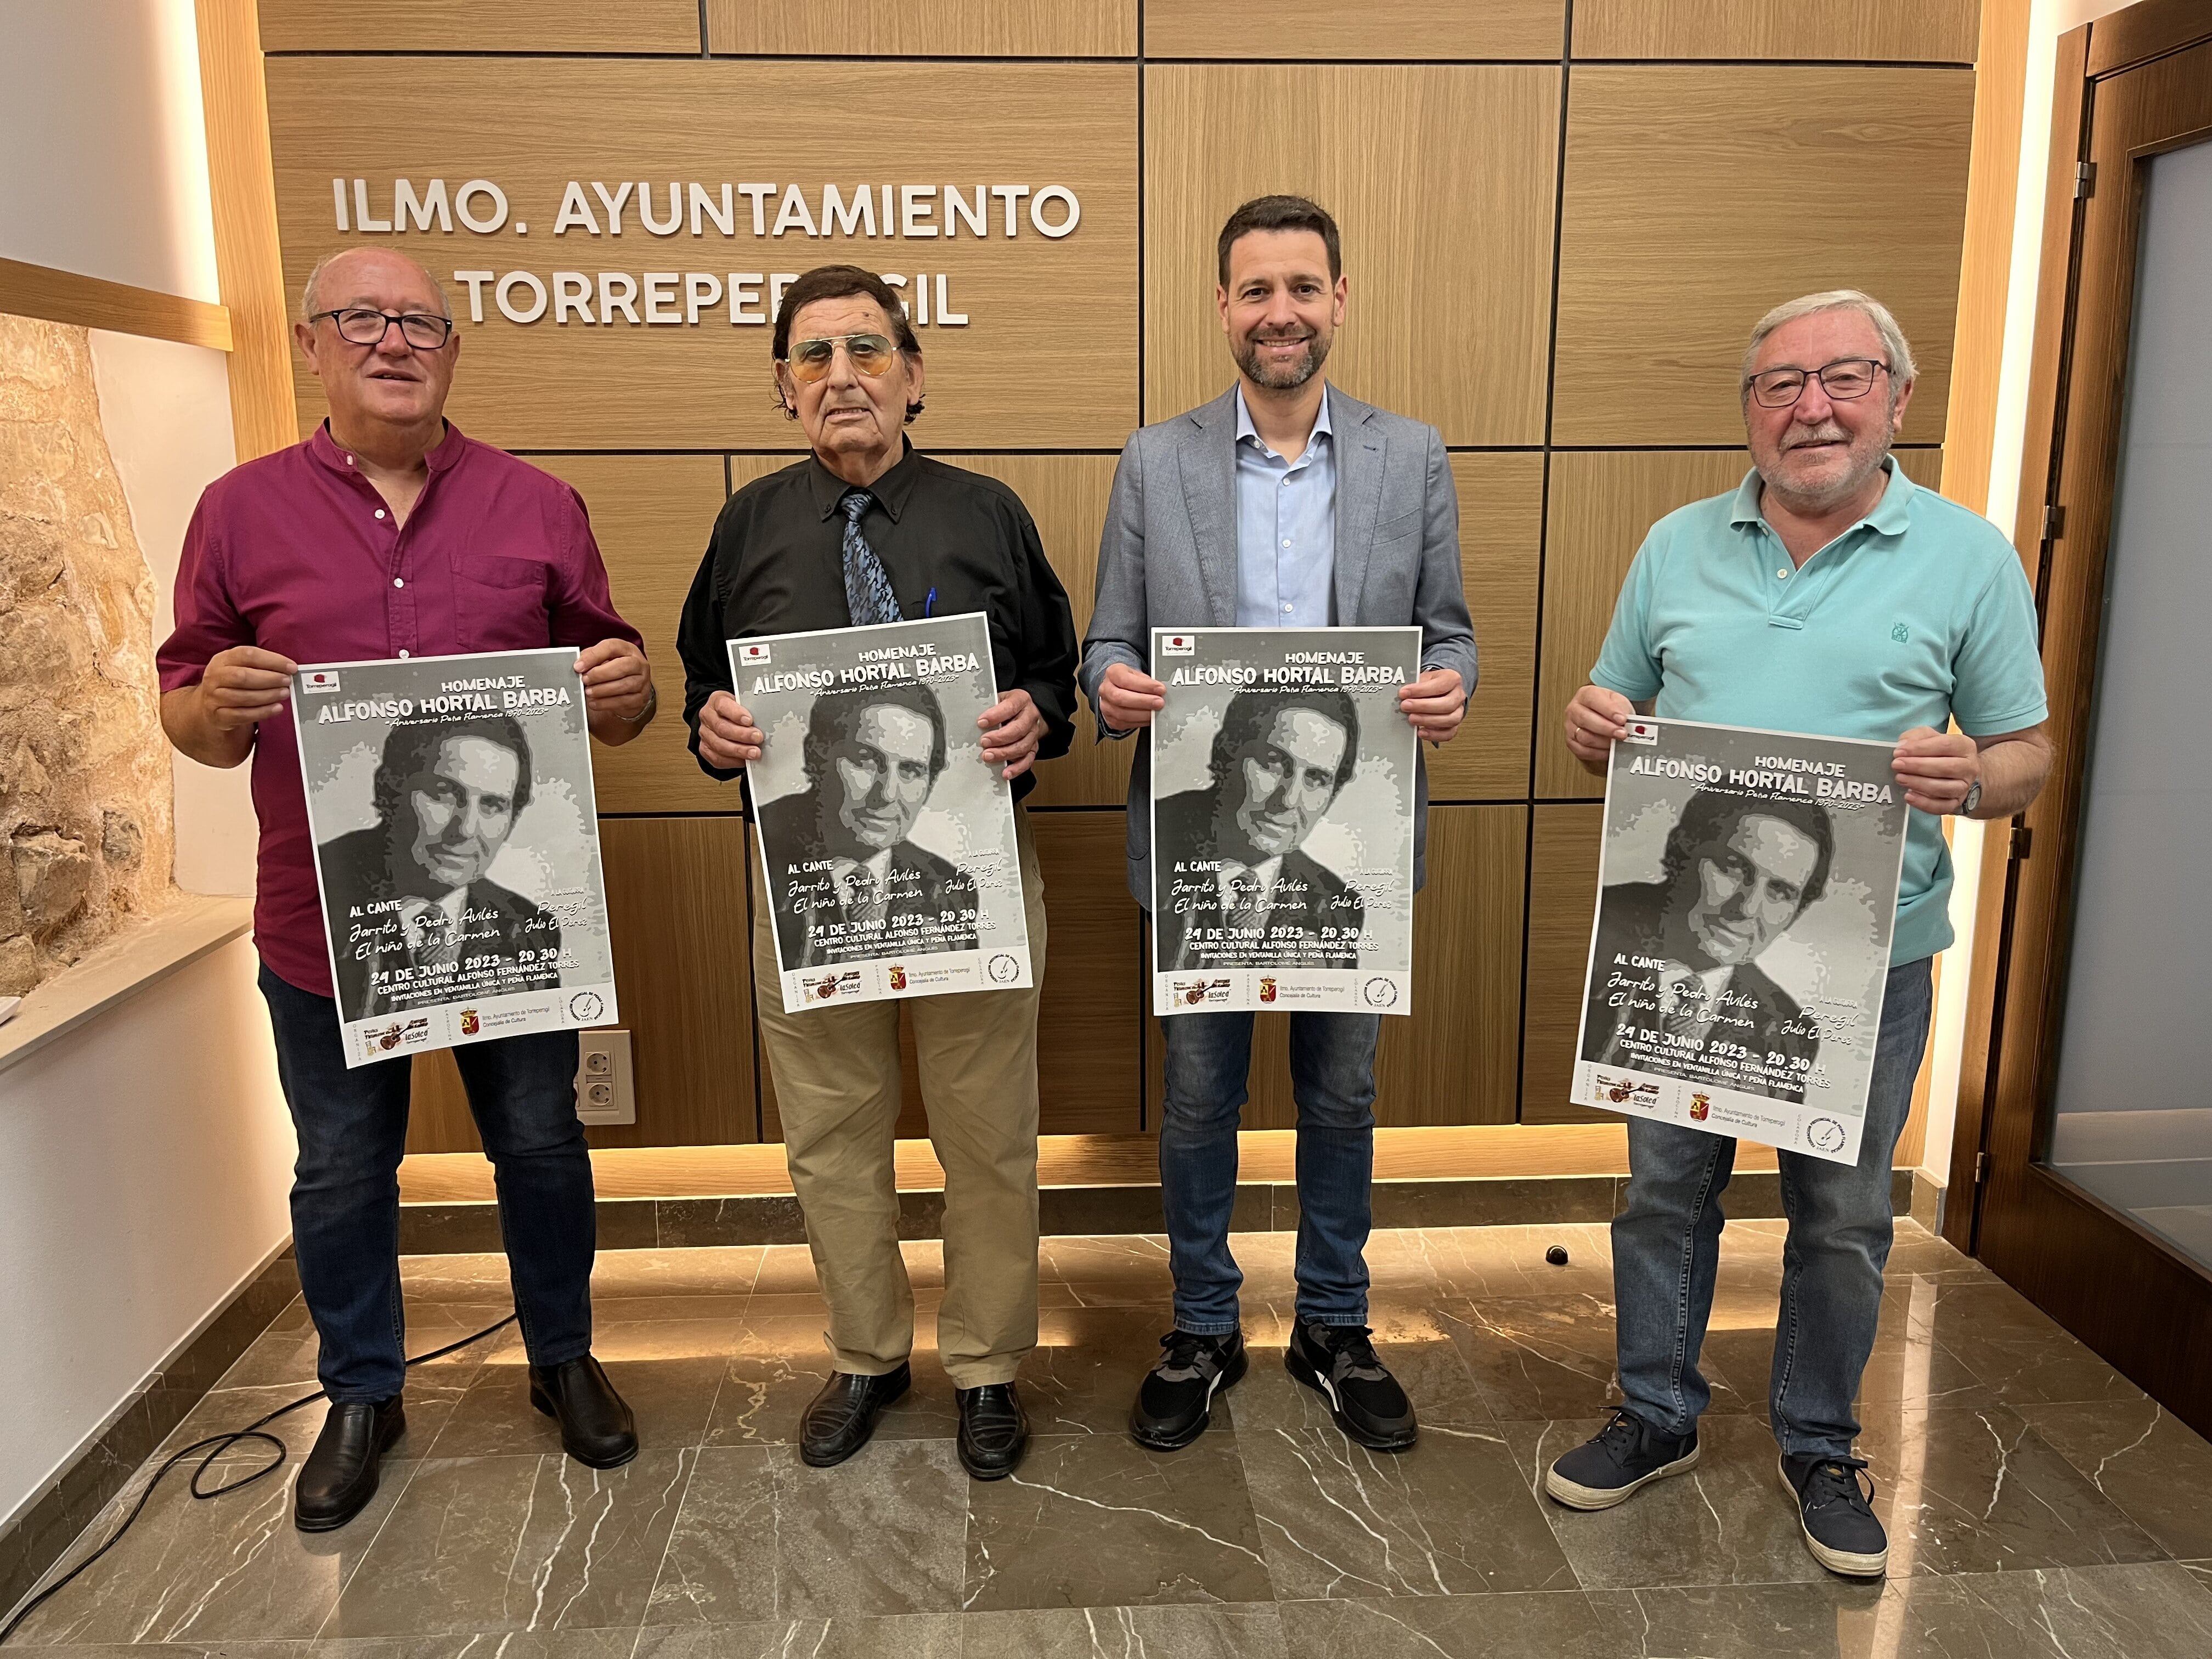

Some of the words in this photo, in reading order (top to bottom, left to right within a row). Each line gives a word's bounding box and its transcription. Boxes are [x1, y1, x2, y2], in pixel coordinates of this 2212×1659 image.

[332, 178, 527, 234] ILMO.
[553, 181, 1081, 238] AYUNTAMIENTO
[453, 270, 969, 326] TORREPEIL
[858, 643, 936, 662] HOMENAJE
[1285, 651, 1364, 664] HOMENAJE
[441, 675, 525, 692] HOMENAJE
[753, 669, 834, 695] ALFONSO
[839, 662, 911, 683] HORTAL
[915, 653, 979, 676] BARBA
[879, 678, 917, 690] Flamenca
[1171, 667, 1257, 686] ALFONSO
[1263, 666, 1334, 684] HORTAL
[1341, 666, 1405, 684] BARBA
[1301, 685, 1339, 693] Flamenca
[318, 699, 413, 724] ALFONSO
[420, 693, 498, 713] HORTAL
[503, 687, 571, 708] BARBA
[462, 709, 504, 721] Flamenca
[1754, 756, 1846, 777] HOMENAJE
[1629, 756, 1722, 783] ALFONSO
[1729, 769, 1809, 794] HORTAL
[1816, 777, 1892, 804] BARBA
[1770, 791, 1813, 805] Flamenca
[786, 863, 800, 874] AL
[802, 860, 834, 872] CANTE
[956, 857, 1002, 879] Peregil
[1174, 861, 1187, 872] AL
[1190, 860, 1221, 872] CANTE
[788, 877, 830, 897] Jarrito
[831, 881, 843, 894] y
[845, 871, 882, 890] Pedro
[884, 868, 921, 885] Avilés
[1171, 878, 1215, 896] Jarrito
[1216, 884, 1226, 897] y
[1229, 877, 1267, 894] Pedro
[1270, 877, 1308, 893] Avilés
[1344, 878, 1395, 897] Peregil
[348, 904, 364, 917] AL
[367, 900, 402, 914] CANTE
[537, 896, 587, 918] Peregil
[793, 898, 808, 914] El
[811, 898, 836, 909] niño
[838, 893, 854, 906] de
[856, 891, 869, 904] la
[872, 889, 923, 905] Carmen
[1175, 898, 1190, 913] El
[1192, 900, 1217, 910] niño
[1221, 898, 1235, 910] de
[1239, 898, 1251, 910] la
[1255, 897, 1307, 912] Carmen
[349, 918, 397, 942] Jarrito
[398, 922, 411, 936] y
[414, 911, 455, 932] Pedro
[459, 907, 498, 925] Avilés
[525, 918, 546, 933] Julio
[548, 916, 559, 930] El
[808, 925, 824, 938] 24
[828, 923, 847, 935] DE
[850, 919, 886, 933] JUNIO
[891, 913, 924, 928] 2023
[940, 909, 975, 923] 20.30
[980, 909, 989, 919] H
[814, 936, 843, 947] CENTRO
[845, 932, 883, 943] CULTURAL
[885, 928, 918, 939] ALFONSO
[921, 921, 965, 935] FERNÁNDEZ
[967, 919, 996, 932] TORRES
[1184, 927, 1202, 940] 24
[1206, 928, 1223, 940] DE
[1227, 927, 1265, 939] JUNIO
[1269, 926, 1304, 939] 2023
[1321, 926, 1359, 941] 20.30
[1363, 929, 1373, 940] H
[355, 941, 371, 960] El
[375, 941, 403, 953] niño
[406, 934, 424, 950] de
[426, 932, 441, 946] la
[444, 929, 500, 946] Carmen
[1189, 941, 1219, 950] CENTRO
[1221, 941, 1260, 949] CULTURAL
[1261, 940, 1297, 949] ALFONSO
[1299, 939, 1346, 949] FERNÁNDEZ
[1348, 941, 1379, 950] TORRES
[370, 971, 389, 985] 24
[394, 967, 415, 982] DE
[418, 961, 459, 978] JUNIO
[465, 954, 500, 970] 2023
[518, 947, 557, 963] 20.30
[562, 947, 572, 958] H
[1613, 952, 1629, 966] AL
[1631, 956, 1666, 971] CANTE
[377, 982, 410, 995] CENTRO
[413, 975, 455, 989] CULTURAL
[457, 969, 494, 982] ALFONSO
[496, 960, 546, 976] FERNÁNDEZ
[548, 958, 579, 970] TORRES
[391, 990, 432, 1001] INVITACIONES
[443, 982, 480, 993] VENTANILLA
[481, 978, 500, 988] ÚNICA
[507, 973, 524, 984] PEÑA
[526, 972, 558, 981] FLAMENCA
[1607, 971, 1655, 991] Jarrito
[1655, 984, 1668, 999] y
[1670, 983, 1712, 1002] Pedro
[1716, 990, 1758, 1009] Avilés
[1609, 992, 1627, 1007] El
[1627, 998, 1655, 1010] niño
[1658, 999, 1677, 1015] de
[1679, 1002, 1694, 1018] la
[1696, 1006, 1754, 1028] Carmen
[1798, 1004, 1859, 1031] Peregil
[1781, 1019, 1805, 1035] Julio
[1807, 1025, 1822, 1039] El
[1616, 1023, 1635, 1039] 24
[1639, 1028, 1659, 1044] DE
[1662, 1032, 1704, 1051] JUNIO
[1709, 1040, 1747, 1059] 2023
[1765, 1051, 1810, 1071] 20.30
[1814, 1063, 1826, 1076] H
[1620, 1039, 1652, 1052] CENTRO
[1654, 1045, 1696, 1061] CULTURAL
[1698, 1054, 1737, 1069] ALFONSO
[1740, 1062, 1794, 1080] FERNÁNDEZ
[1795, 1073, 1831, 1088] TORRES
